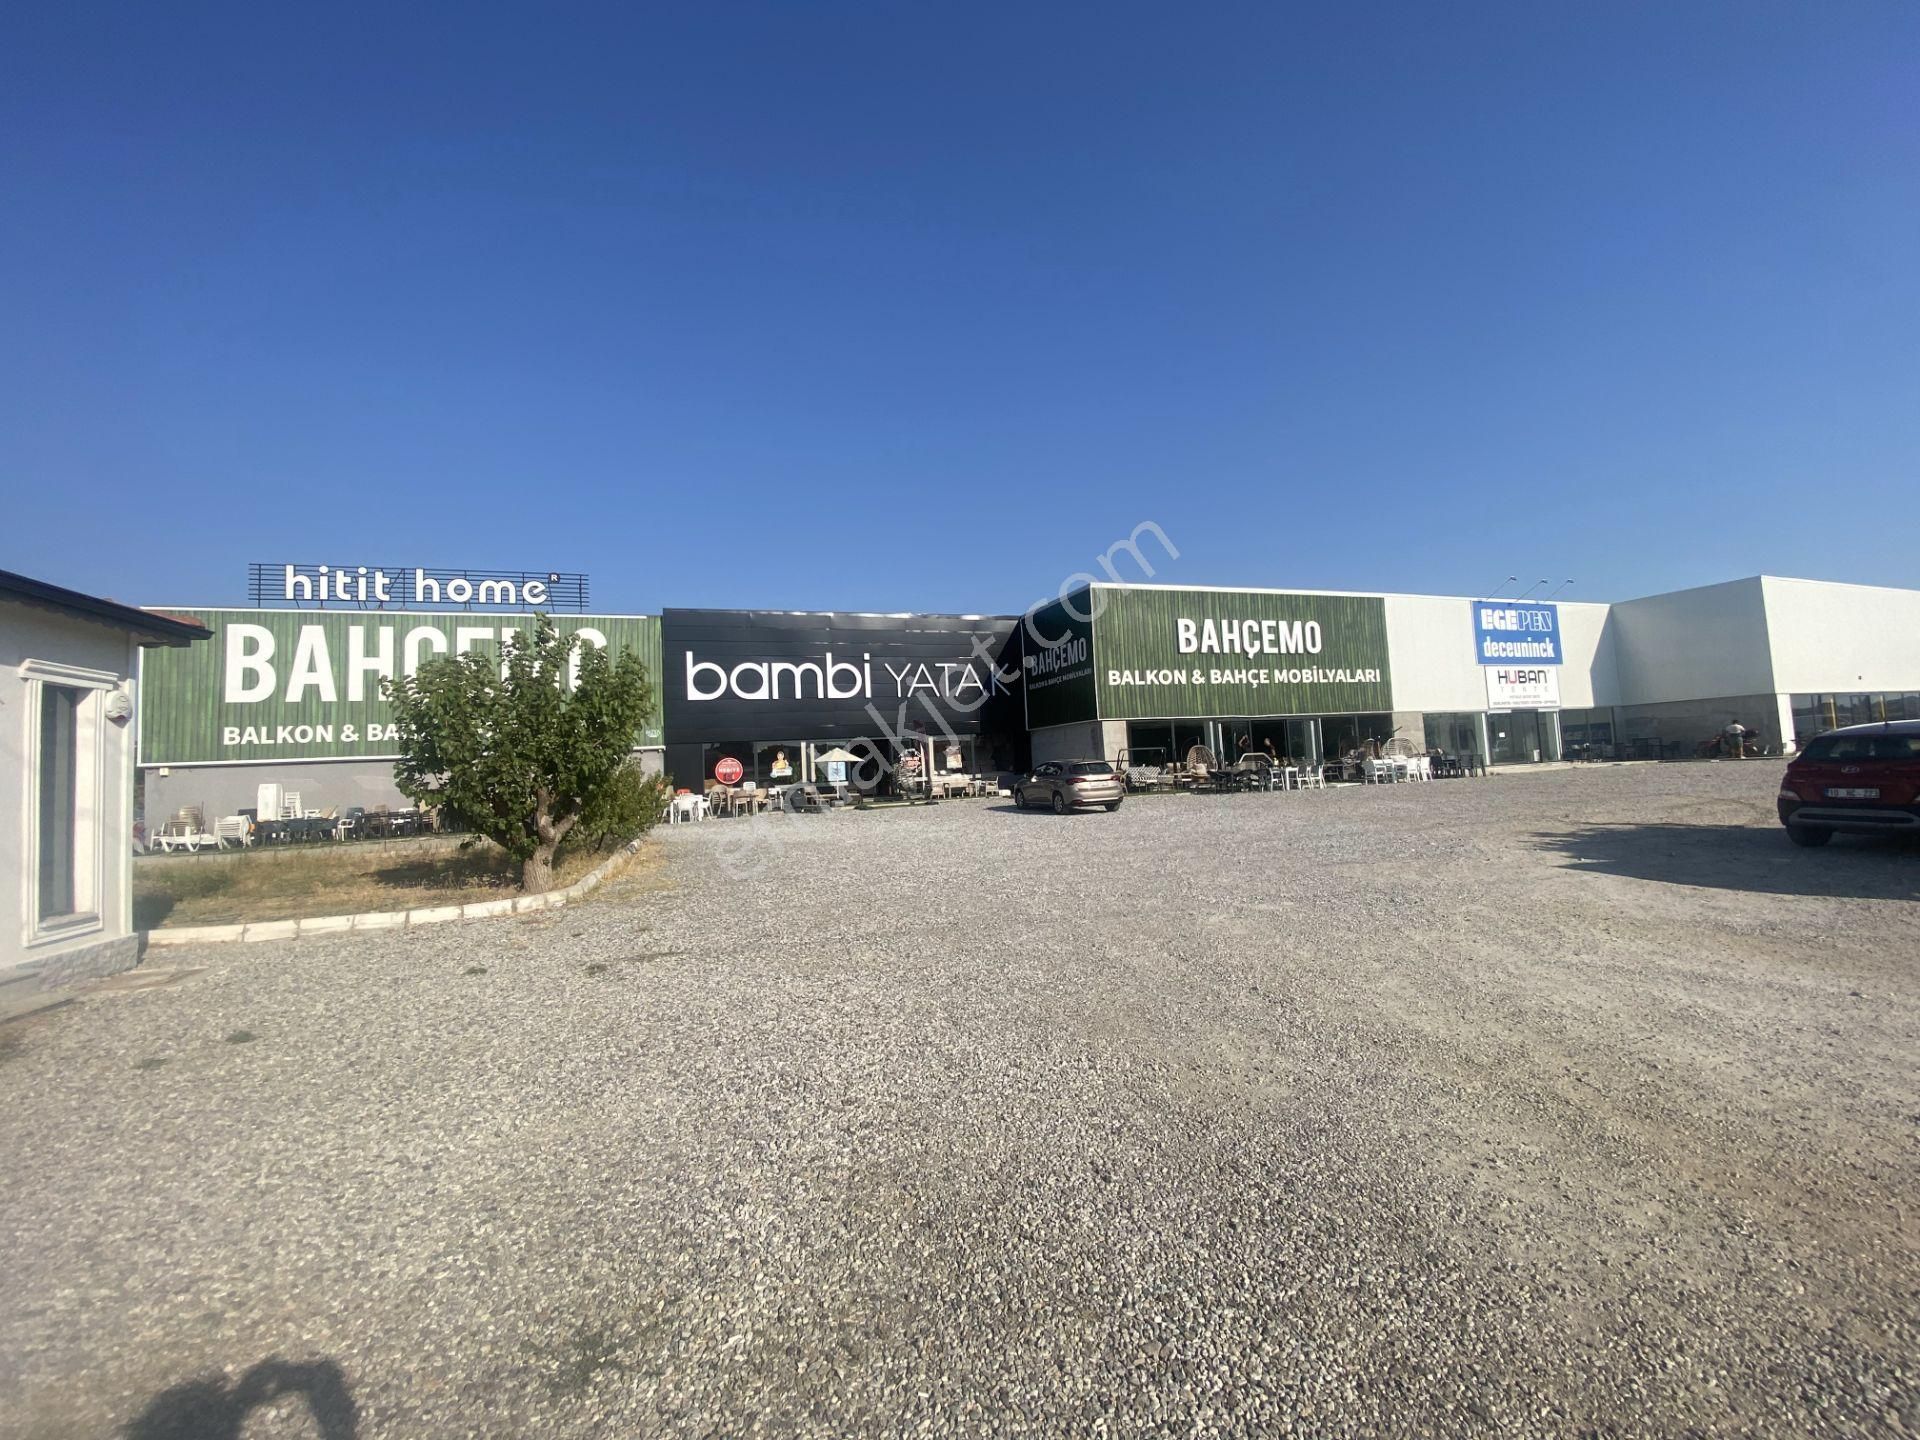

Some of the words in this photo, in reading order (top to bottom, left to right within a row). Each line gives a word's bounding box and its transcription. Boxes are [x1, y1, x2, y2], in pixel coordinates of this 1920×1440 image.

[285, 565, 390, 601] hitit
[415, 569, 548, 605] home
[1480, 608, 1552, 631] EGEPEN
[1177, 618, 1322, 658] BAHÇEMO
[1483, 636, 1555, 657] deceuninck
[686, 651, 871, 700] bambi
[884, 662, 1011, 698] YATAK
[1108, 670, 1187, 686] BALKON
[1191, 670, 1206, 684] &
[1210, 669, 1270, 688] BAHÇE
[1274, 665, 1380, 684] MOBİLYALARI
[1497, 670, 1547, 684] HUBAN
[223, 725, 333, 745] BALKON
[341, 724, 359, 742] &
